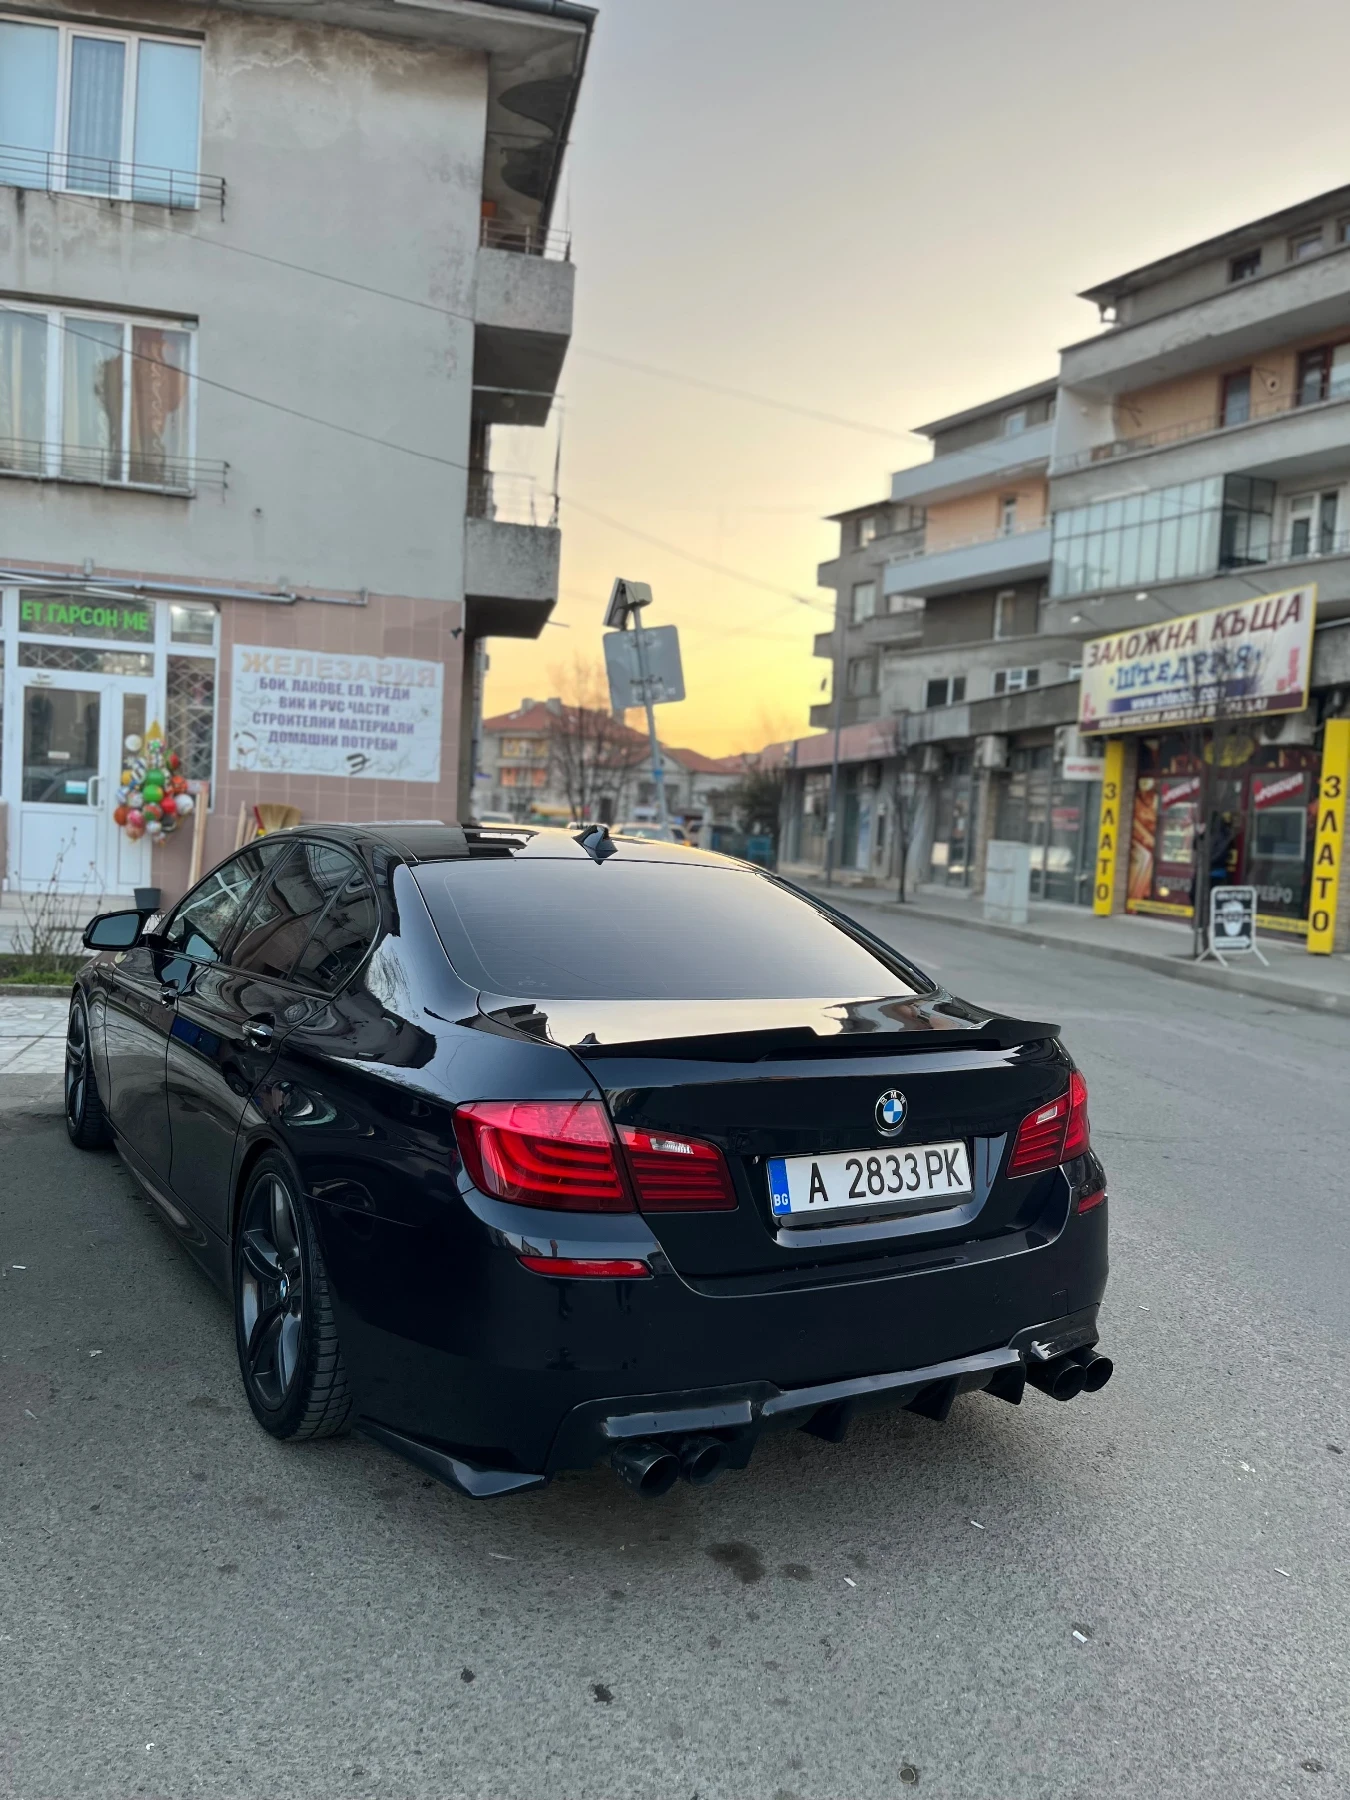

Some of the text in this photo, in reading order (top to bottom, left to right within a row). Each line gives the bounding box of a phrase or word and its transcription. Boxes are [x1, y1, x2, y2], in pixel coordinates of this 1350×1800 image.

[21, 600, 149, 632] ЕТ ГАРСОН МЕ
[1086, 592, 1304, 667] ЗАЛОЖНА КЪЩА
[240, 652, 436, 688] ЖЕЛЕЗАРИЯ
[369, 685, 411, 701] УРЕДИ
[279, 696, 390, 717] ВИК И PVC ЧАСТИ
[252, 711, 415, 735] СТРОИТЕЛНИ МАТЕРИАЛИ
[267, 730, 398, 751] ДОМАШНИ ПОТРЕБИ
[1096, 782, 1117, 901] ЗЛАТО
[1311, 774, 1341, 933] ЗЛАТО
[1255, 884, 1293, 905] РЕБРО
[879, 1090, 907, 1106] BMW
[808, 1162, 829, 1204] A
[773, 1193, 790, 1207] BG
